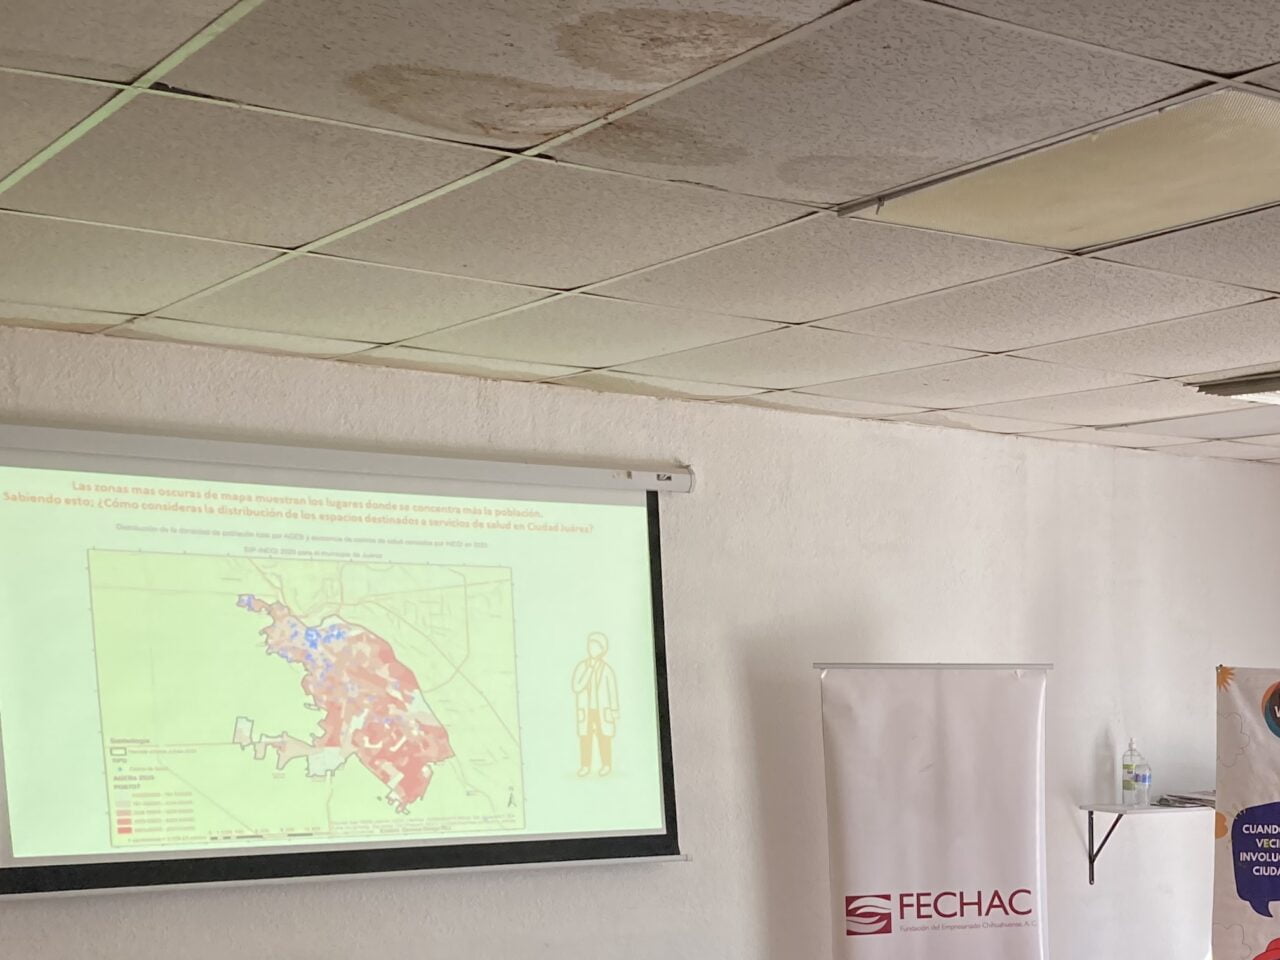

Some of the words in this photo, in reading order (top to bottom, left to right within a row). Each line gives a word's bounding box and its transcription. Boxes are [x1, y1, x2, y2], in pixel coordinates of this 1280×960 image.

[3, 491, 62, 505] Sabiendo
[141, 501, 203, 513] consideras
[217, 504, 283, 518] distribución
[284, 509, 299, 519] de
[301, 510, 317, 520] los
[319, 513, 363, 523] espacios
[364, 514, 419, 525] destinados
[429, 518, 470, 528] servicios
[72, 480, 93, 492] Las
[95, 484, 129, 493] zonas
[158, 488, 202, 498] oscuras
[204, 488, 219, 500] de
[221, 493, 253, 503] mapa
[255, 494, 306, 505] muestran
[308, 496, 323, 506] los
[325, 498, 364, 510] lugares
[365, 500, 397, 511] donde
[399, 504, 410, 512] se
[412, 504, 461, 514] concentra
[899, 889, 1032, 920] FECHAC
